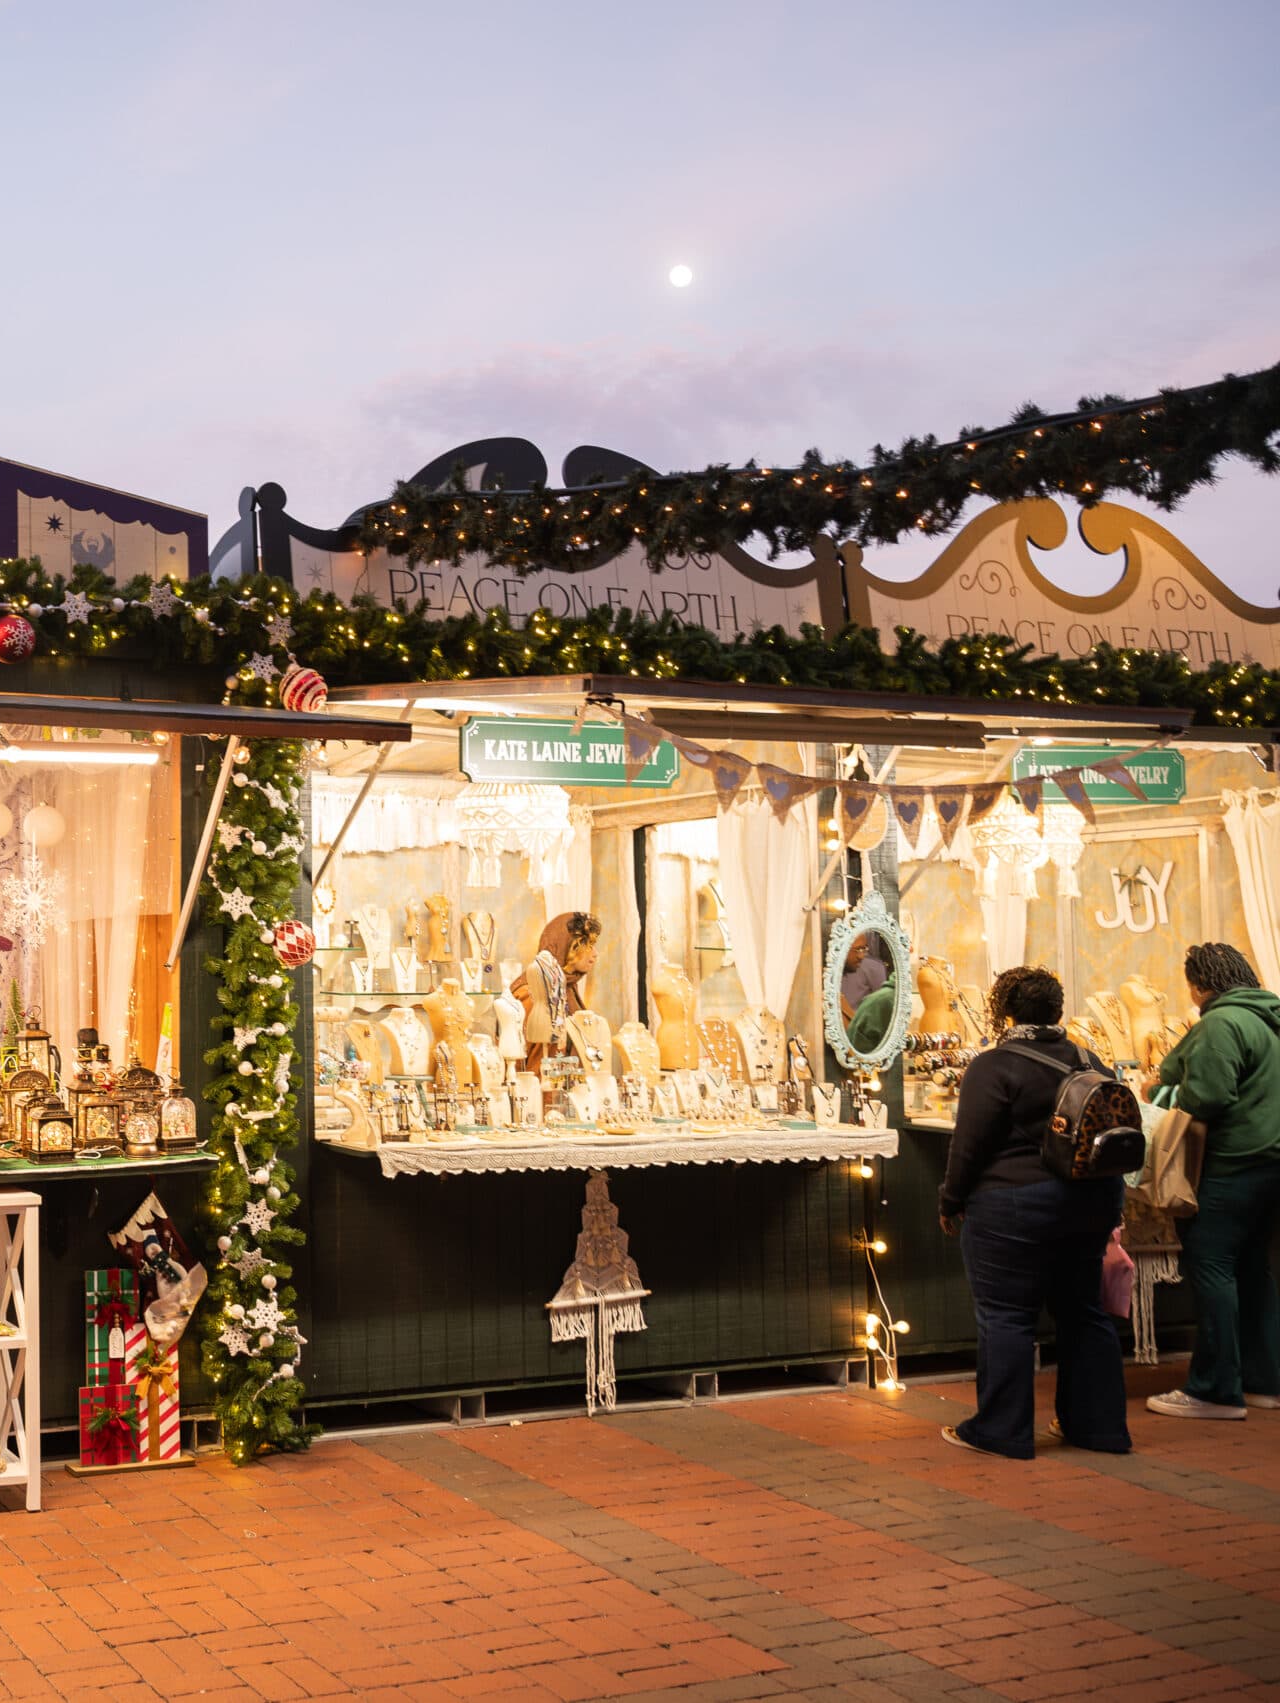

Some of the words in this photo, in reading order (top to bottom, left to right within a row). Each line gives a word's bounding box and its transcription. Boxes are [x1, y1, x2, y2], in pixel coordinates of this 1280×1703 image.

[388, 569, 528, 618] PEACE
[538, 582, 594, 621] ON
[605, 586, 739, 632] EARTH
[945, 613, 1056, 656] PEACE
[1067, 623, 1111, 657] ON
[1121, 626, 1233, 664] EARTH
[484, 739, 528, 761] KATE
[532, 741, 582, 763] LAINE
[585, 743, 661, 766] JEWEY
[1067, 766, 1108, 785] INE
[1110, 766, 1170, 785] WELRY
[1095, 861, 1174, 933] JOY
